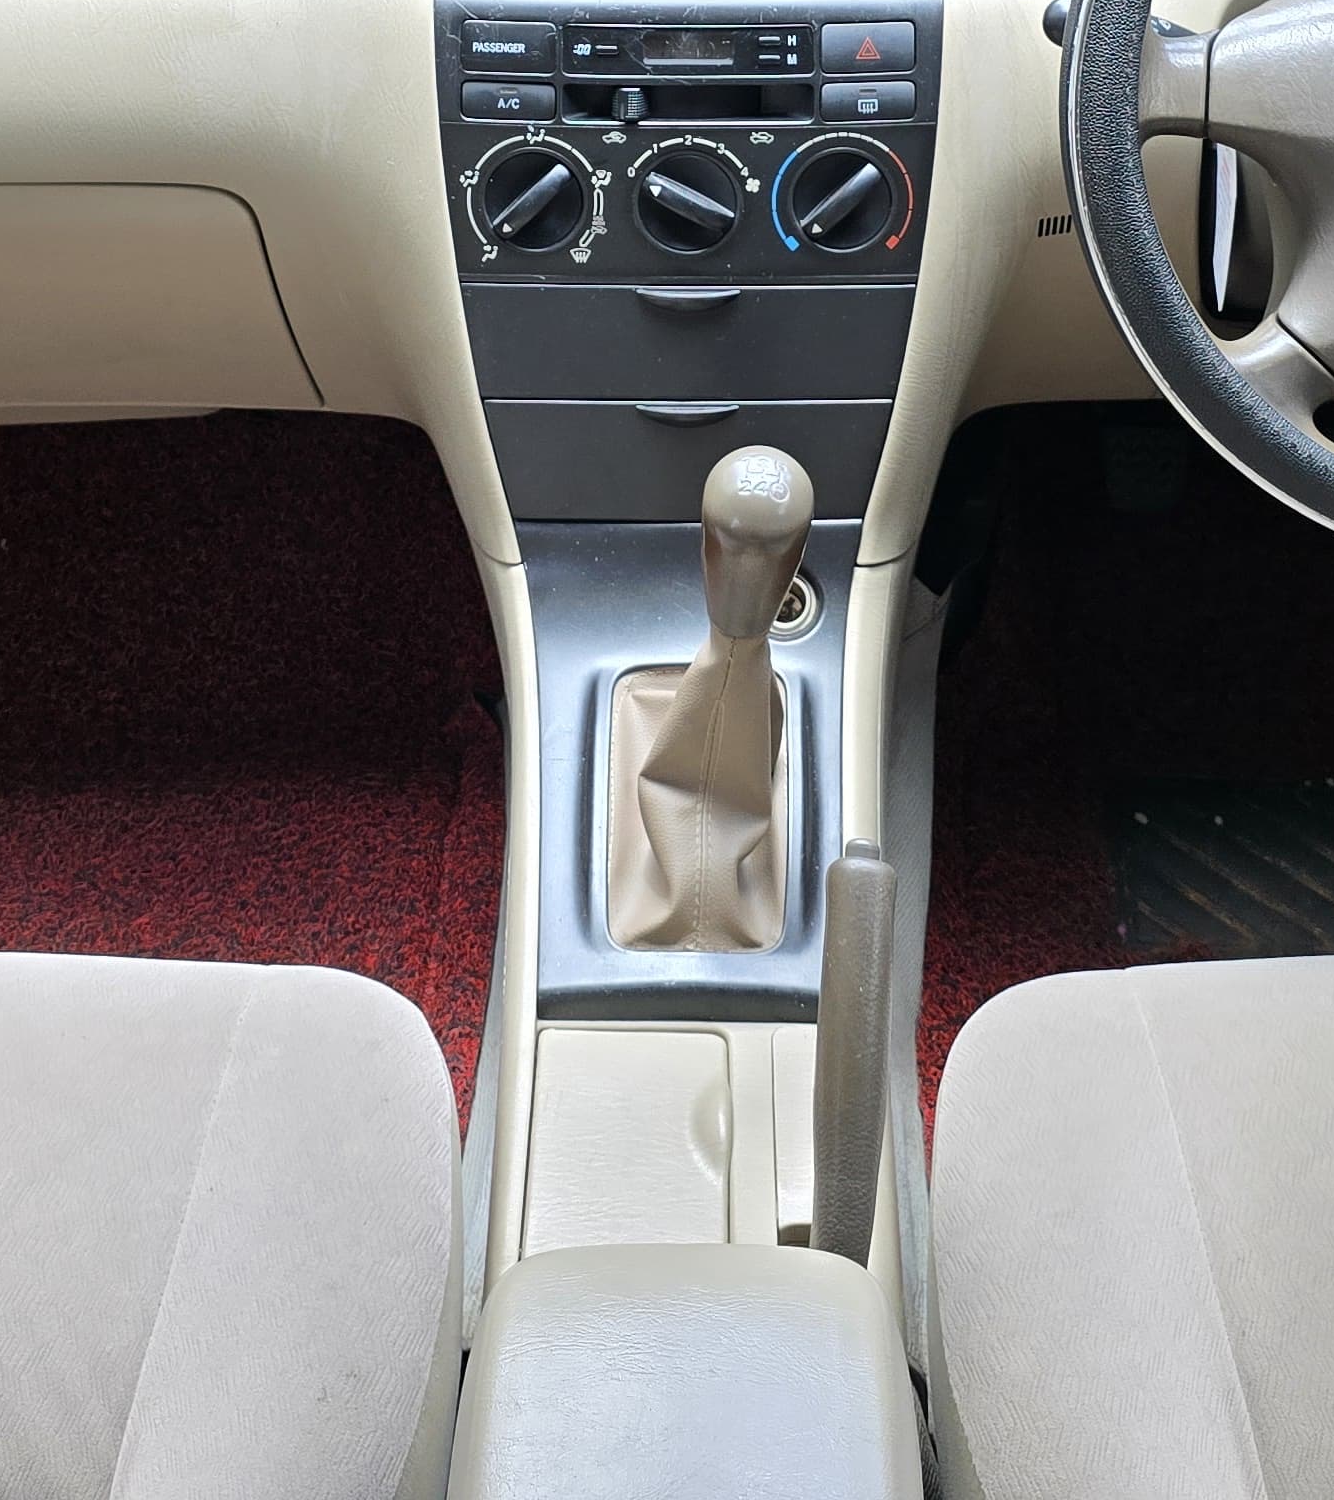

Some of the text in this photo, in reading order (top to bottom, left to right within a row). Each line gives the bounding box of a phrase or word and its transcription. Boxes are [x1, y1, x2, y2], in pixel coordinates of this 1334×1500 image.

[787, 35, 797, 46] H
[472, 42, 526, 54] PASSENGER
[786, 53, 798, 65] M
[497, 98, 520, 110] A/C
[684, 135, 693, 146] 2
[652, 143, 658, 154] 1
[717, 143, 726, 155] 3
[627, 166, 636, 178] 0
[740, 166, 749, 177] 4
[738, 480, 752, 494] 2
[753, 481, 767, 494] 4
